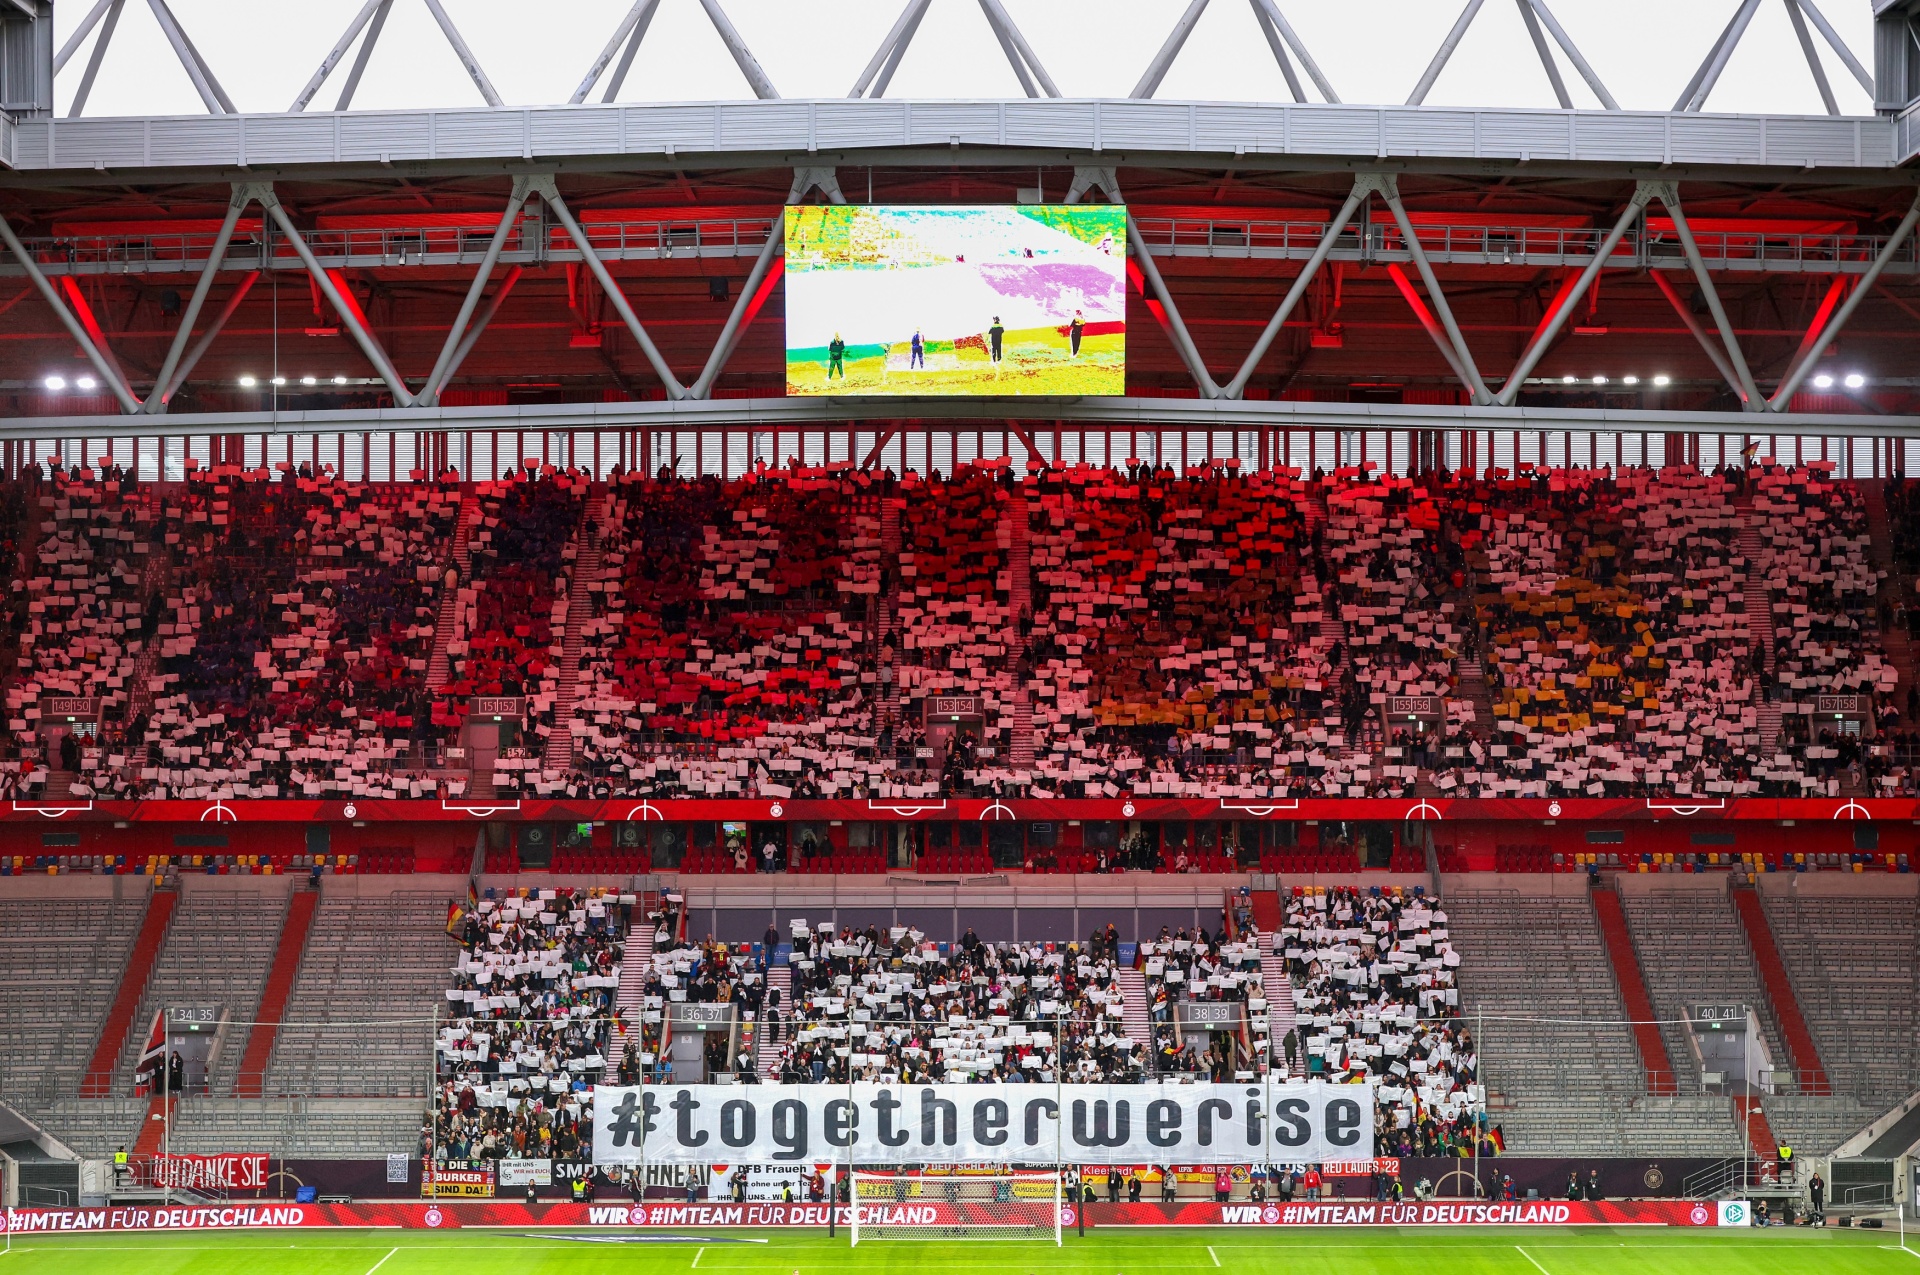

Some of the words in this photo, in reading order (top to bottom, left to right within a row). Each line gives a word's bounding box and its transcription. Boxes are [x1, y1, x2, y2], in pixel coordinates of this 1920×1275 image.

[54, 701, 71, 712] 149
[72, 701, 89, 712] 150
[483, 701, 497, 712] 151
[498, 701, 515, 712] 152
[939, 700, 955, 711] 153
[956, 700, 972, 711] 154
[1395, 700, 1411, 710] 155
[1412, 700, 1429, 710] 156
[1821, 699, 1837, 709] 157
[1839, 699, 1856, 709] 158
[179, 1009, 193, 1021] 34
[200, 1009, 213, 1020] 35
[687, 1009, 701, 1020] 36
[707, 1009, 720, 1020] 37
[1194, 1008, 1208, 1019] 38
[1214, 1008, 1228, 1019] 39
[1701, 1008, 1715, 1019] 40
[1722, 1008, 1735, 1019] 41
[607, 1088, 1361, 1160] #togetherwerise
[448, 1160, 468, 1170] DIE
[737, 1164, 762, 1174] DFB
[766, 1164, 807, 1174] Frauen
[1083, 1165, 1134, 1176] Kleesadt
[1323, 1163, 1342, 1174] RED
[1344, 1161, 1380, 1174] LADIES
[1382, 1160, 1399, 1173] '22
[181, 1157, 238, 1188] DANKE
[241, 1156, 267, 1187] SIE
[556, 1164, 598, 1179] SMD
[435, 1173, 482, 1183] BURKER
[434, 1185, 460, 1194] SIND
[465, 1185, 484, 1195] DA!
[110, 1207, 150, 1228] FÜR
[153, 1208, 304, 1227] DEUTSCHLAND
[589, 1207, 629, 1224] WIR
[650, 1206, 742, 1224] #IMTEAM
[748, 1203, 787, 1224] FÜR
[789, 1206, 937, 1225] DEUTSCHLAND
[1222, 1206, 1263, 1223] WIR
[1283, 1206, 1375, 1224] #IMTEAM
[1380, 1202, 1418, 1223] FÜR
[1422, 1205, 1570, 1223] DEUTSCHLAND
